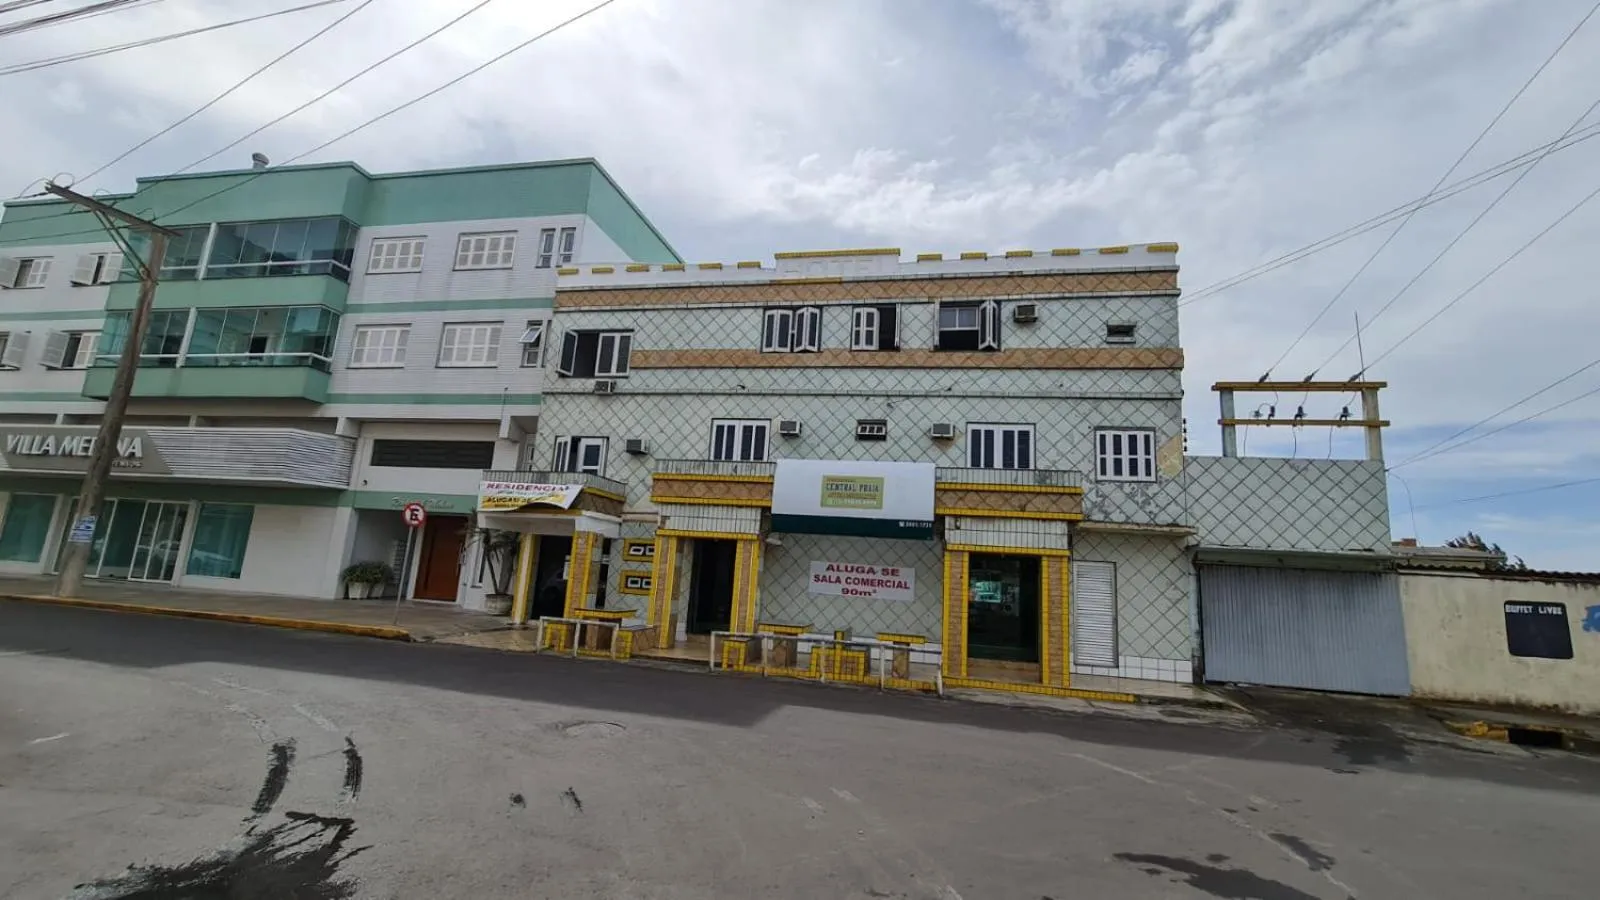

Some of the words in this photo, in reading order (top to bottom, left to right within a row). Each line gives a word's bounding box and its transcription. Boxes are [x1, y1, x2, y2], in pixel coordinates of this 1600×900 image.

[6, 434, 56, 455] VILLA
[58, 435, 143, 458] MENA
[825, 482, 856, 492] CENTRAL
[859, 483, 879, 493] PRAIA
[410, 508, 420, 521] E
[825, 563, 876, 575] ALUGA
[880, 567, 900, 577] SE
[813, 574, 842, 585] SALA
[845, 576, 910, 589] COMERCIAL
[1505, 604, 1533, 614] BUFFET
